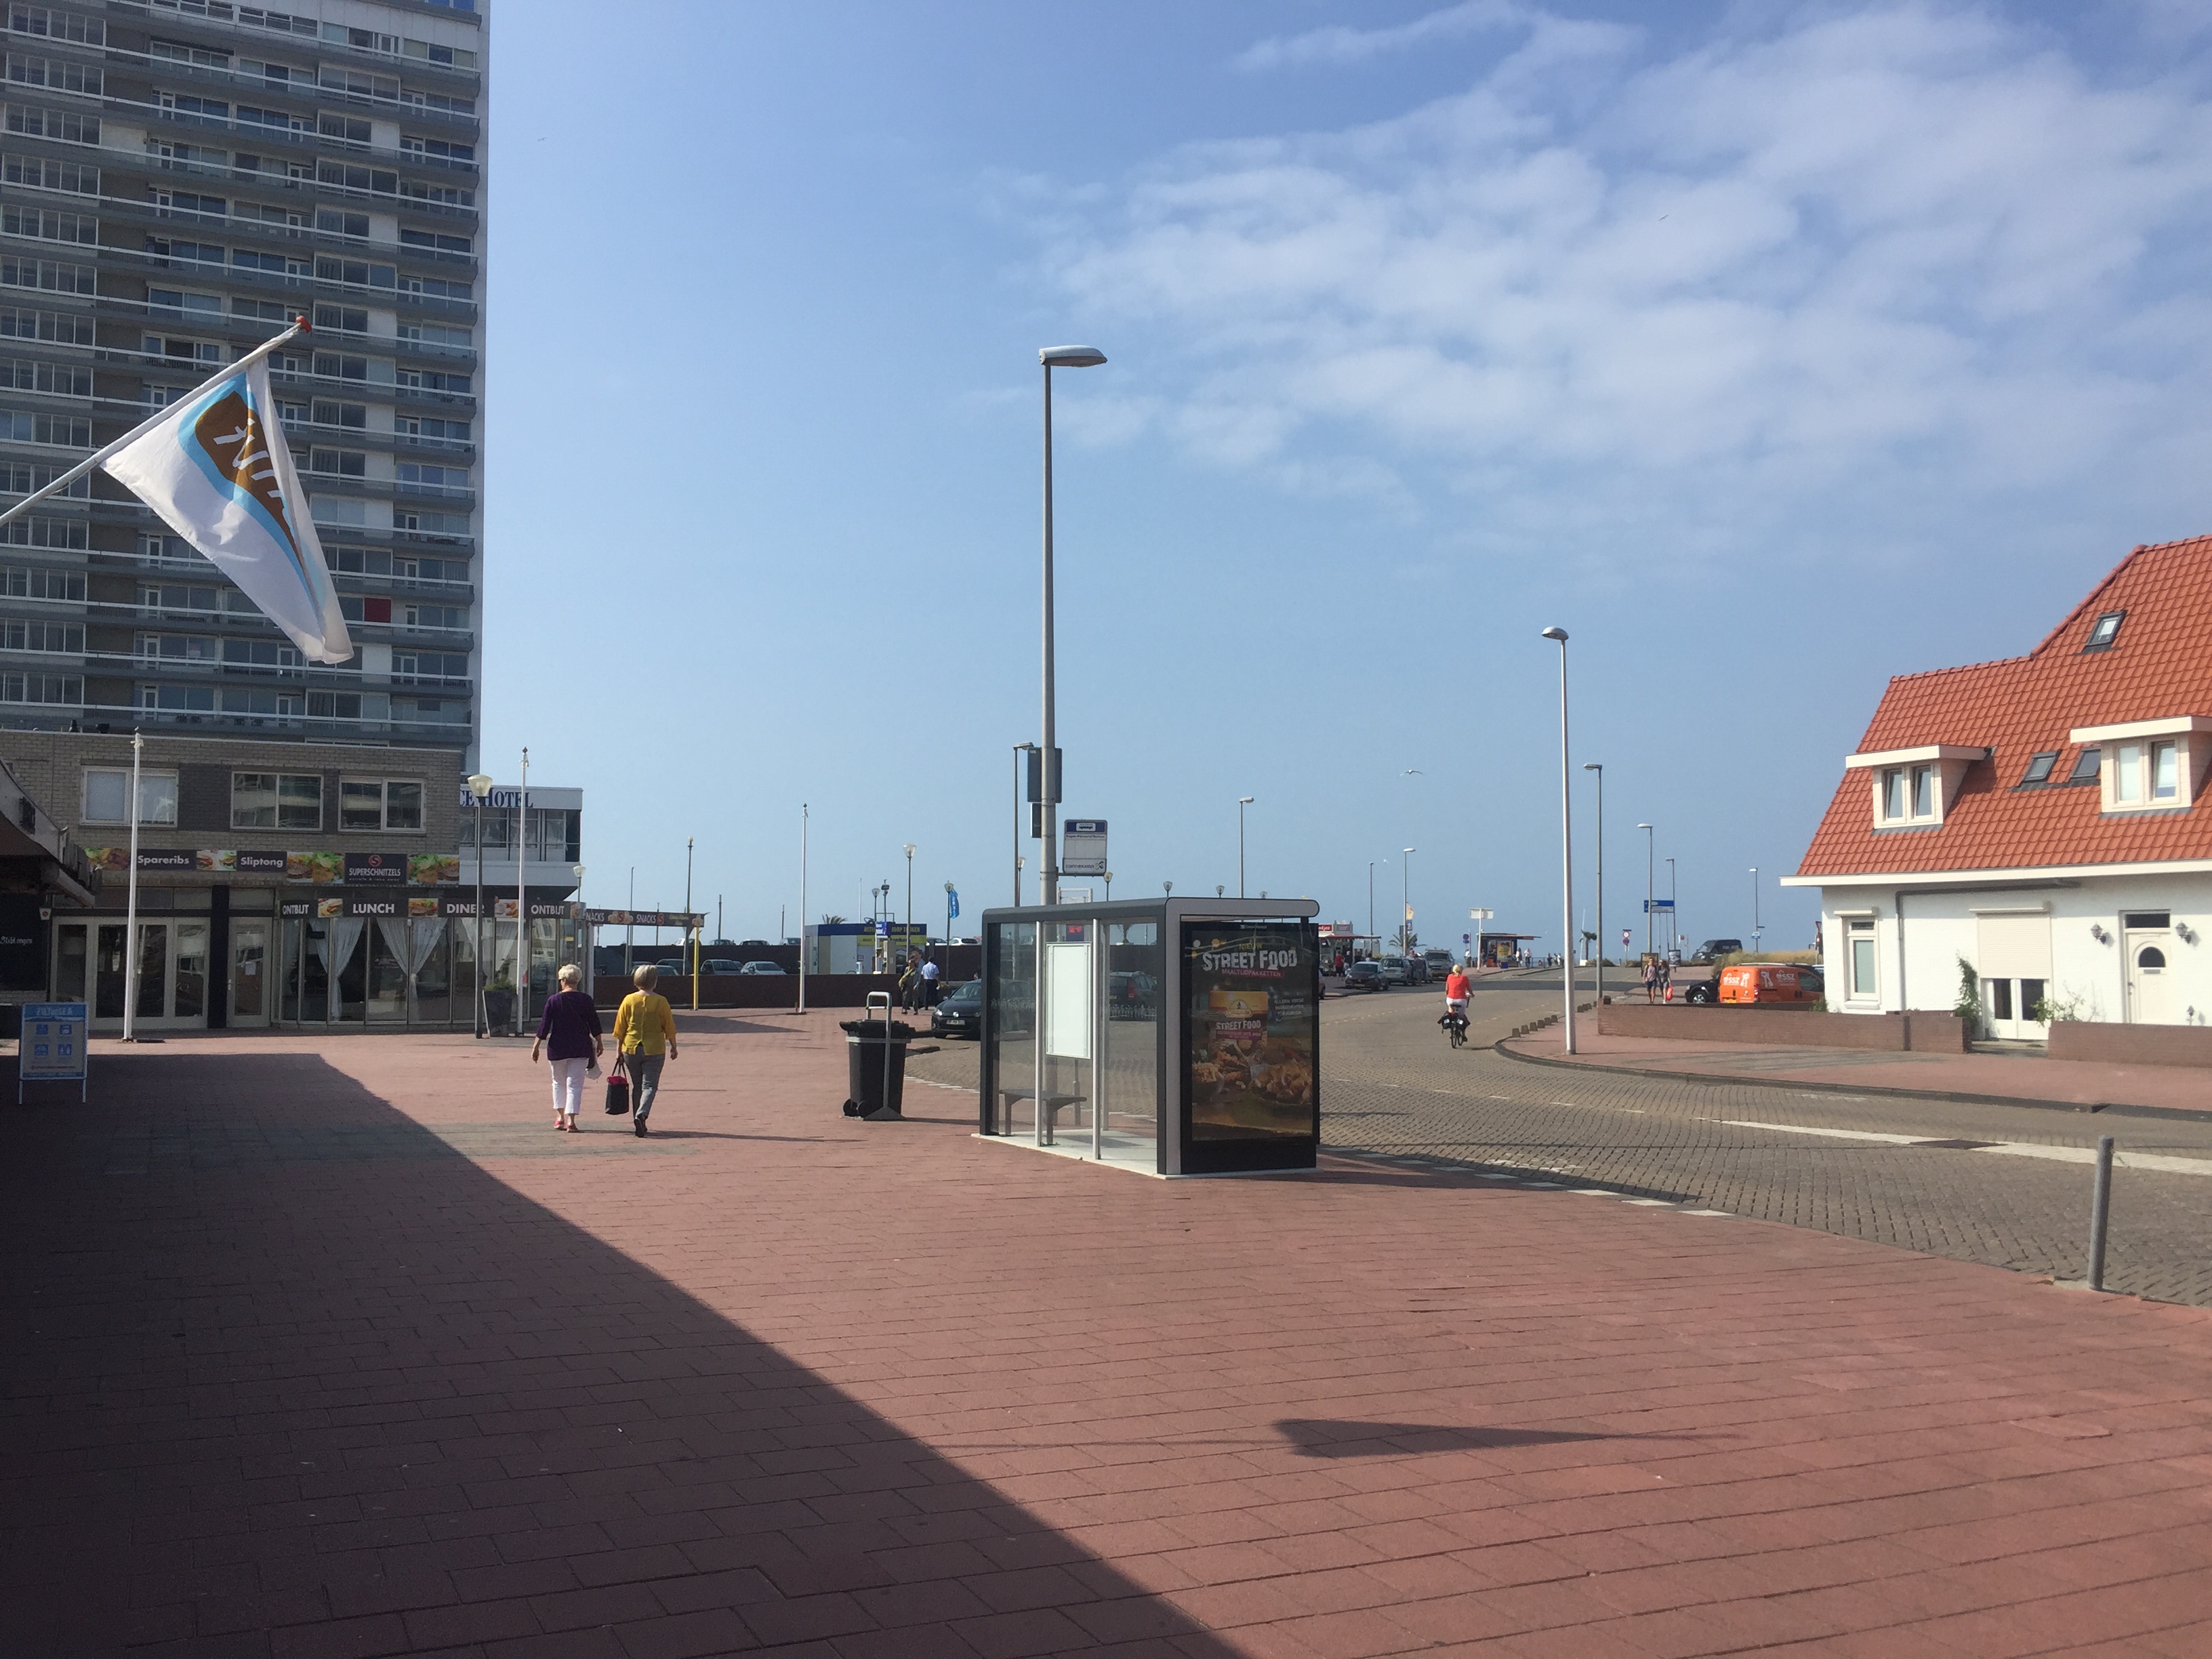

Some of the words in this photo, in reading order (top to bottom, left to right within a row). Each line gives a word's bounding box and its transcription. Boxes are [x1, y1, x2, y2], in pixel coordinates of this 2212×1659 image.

[137, 855, 190, 866] Spareribs
[240, 857, 284, 868] Sliptong
[349, 867, 401, 877] SUPERSCHNITZELS
[282, 904, 309, 915] ONTBIJT
[352, 903, 395, 914] LUNCH
[447, 903, 485, 914] DINER
[531, 905, 565, 915] ONTBIJT
[586, 912, 605, 922] NACKS
[636, 914, 657, 924] SNACKS
[1202, 951, 1256, 972] STREET
[1259, 949, 1298, 970] FOOD
[1215, 1021, 1242, 1030] STREET
[1242, 1019, 1261, 1029] FOOD
